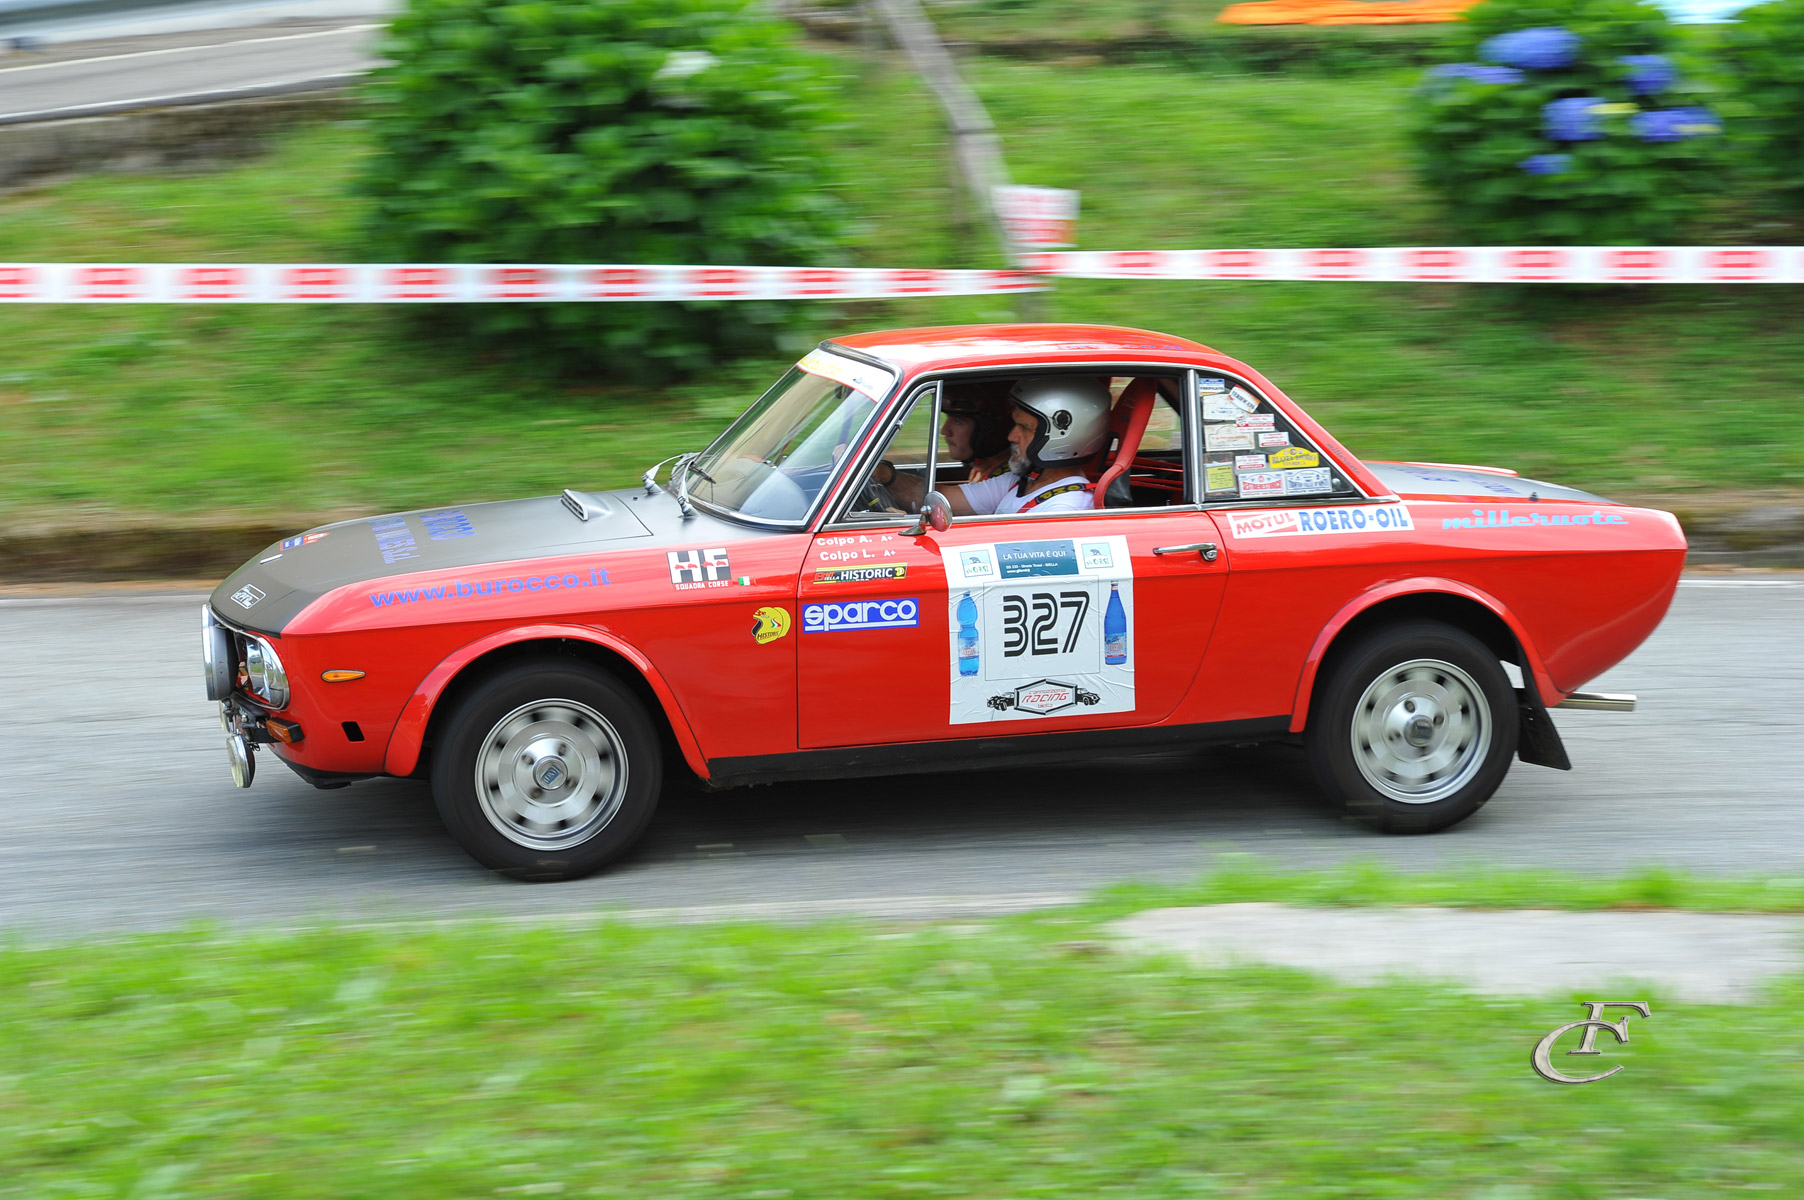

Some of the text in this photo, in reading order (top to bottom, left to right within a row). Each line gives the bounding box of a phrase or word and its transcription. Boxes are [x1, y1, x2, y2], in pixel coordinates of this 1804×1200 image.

[1236, 508, 1408, 535] MOTUL ROERO-OIL
[1442, 509, 1629, 529] milleruote
[816, 537, 855, 546] Colpo
[859, 535, 873, 543] A.
[820, 551, 858, 561] Colpo
[862, 549, 875, 558] L.
[667, 548, 730, 583] HF
[840, 568, 893, 580] HISTORIC
[369, 568, 611, 607] www.burocco.it
[675, 580, 729, 590] SQUADRA CORSE
[804, 600, 917, 631] sparco
[1003, 591, 1090, 657] 327
[1021, 693, 1069, 703] RACING
